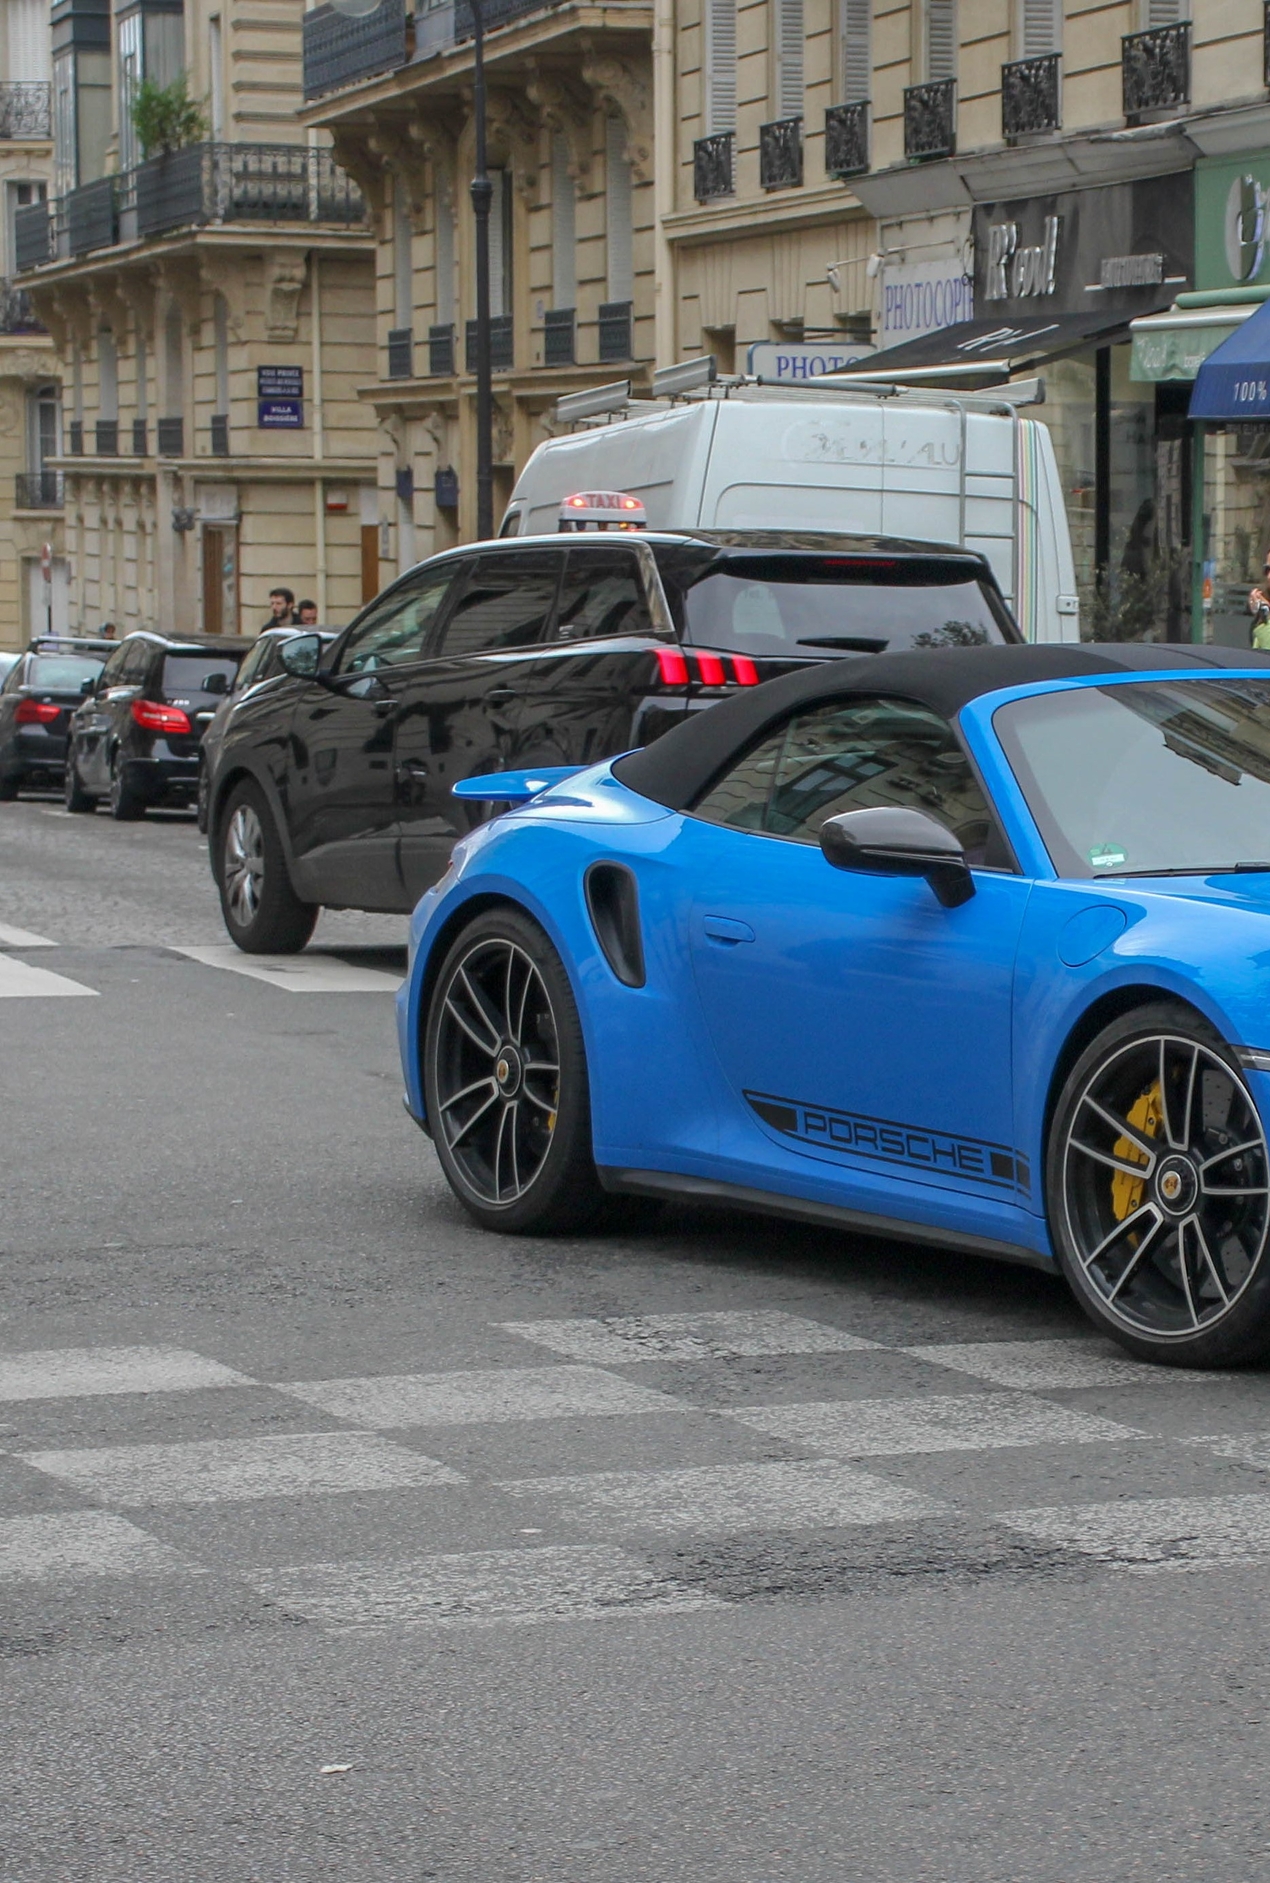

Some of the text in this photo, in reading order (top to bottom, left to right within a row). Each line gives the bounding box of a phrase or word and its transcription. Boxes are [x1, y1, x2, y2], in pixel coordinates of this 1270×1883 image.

[1233, 381, 1267, 401] 100%
[587, 494, 620, 508] TAXI
[804, 1111, 985, 1173] PORSCHE
